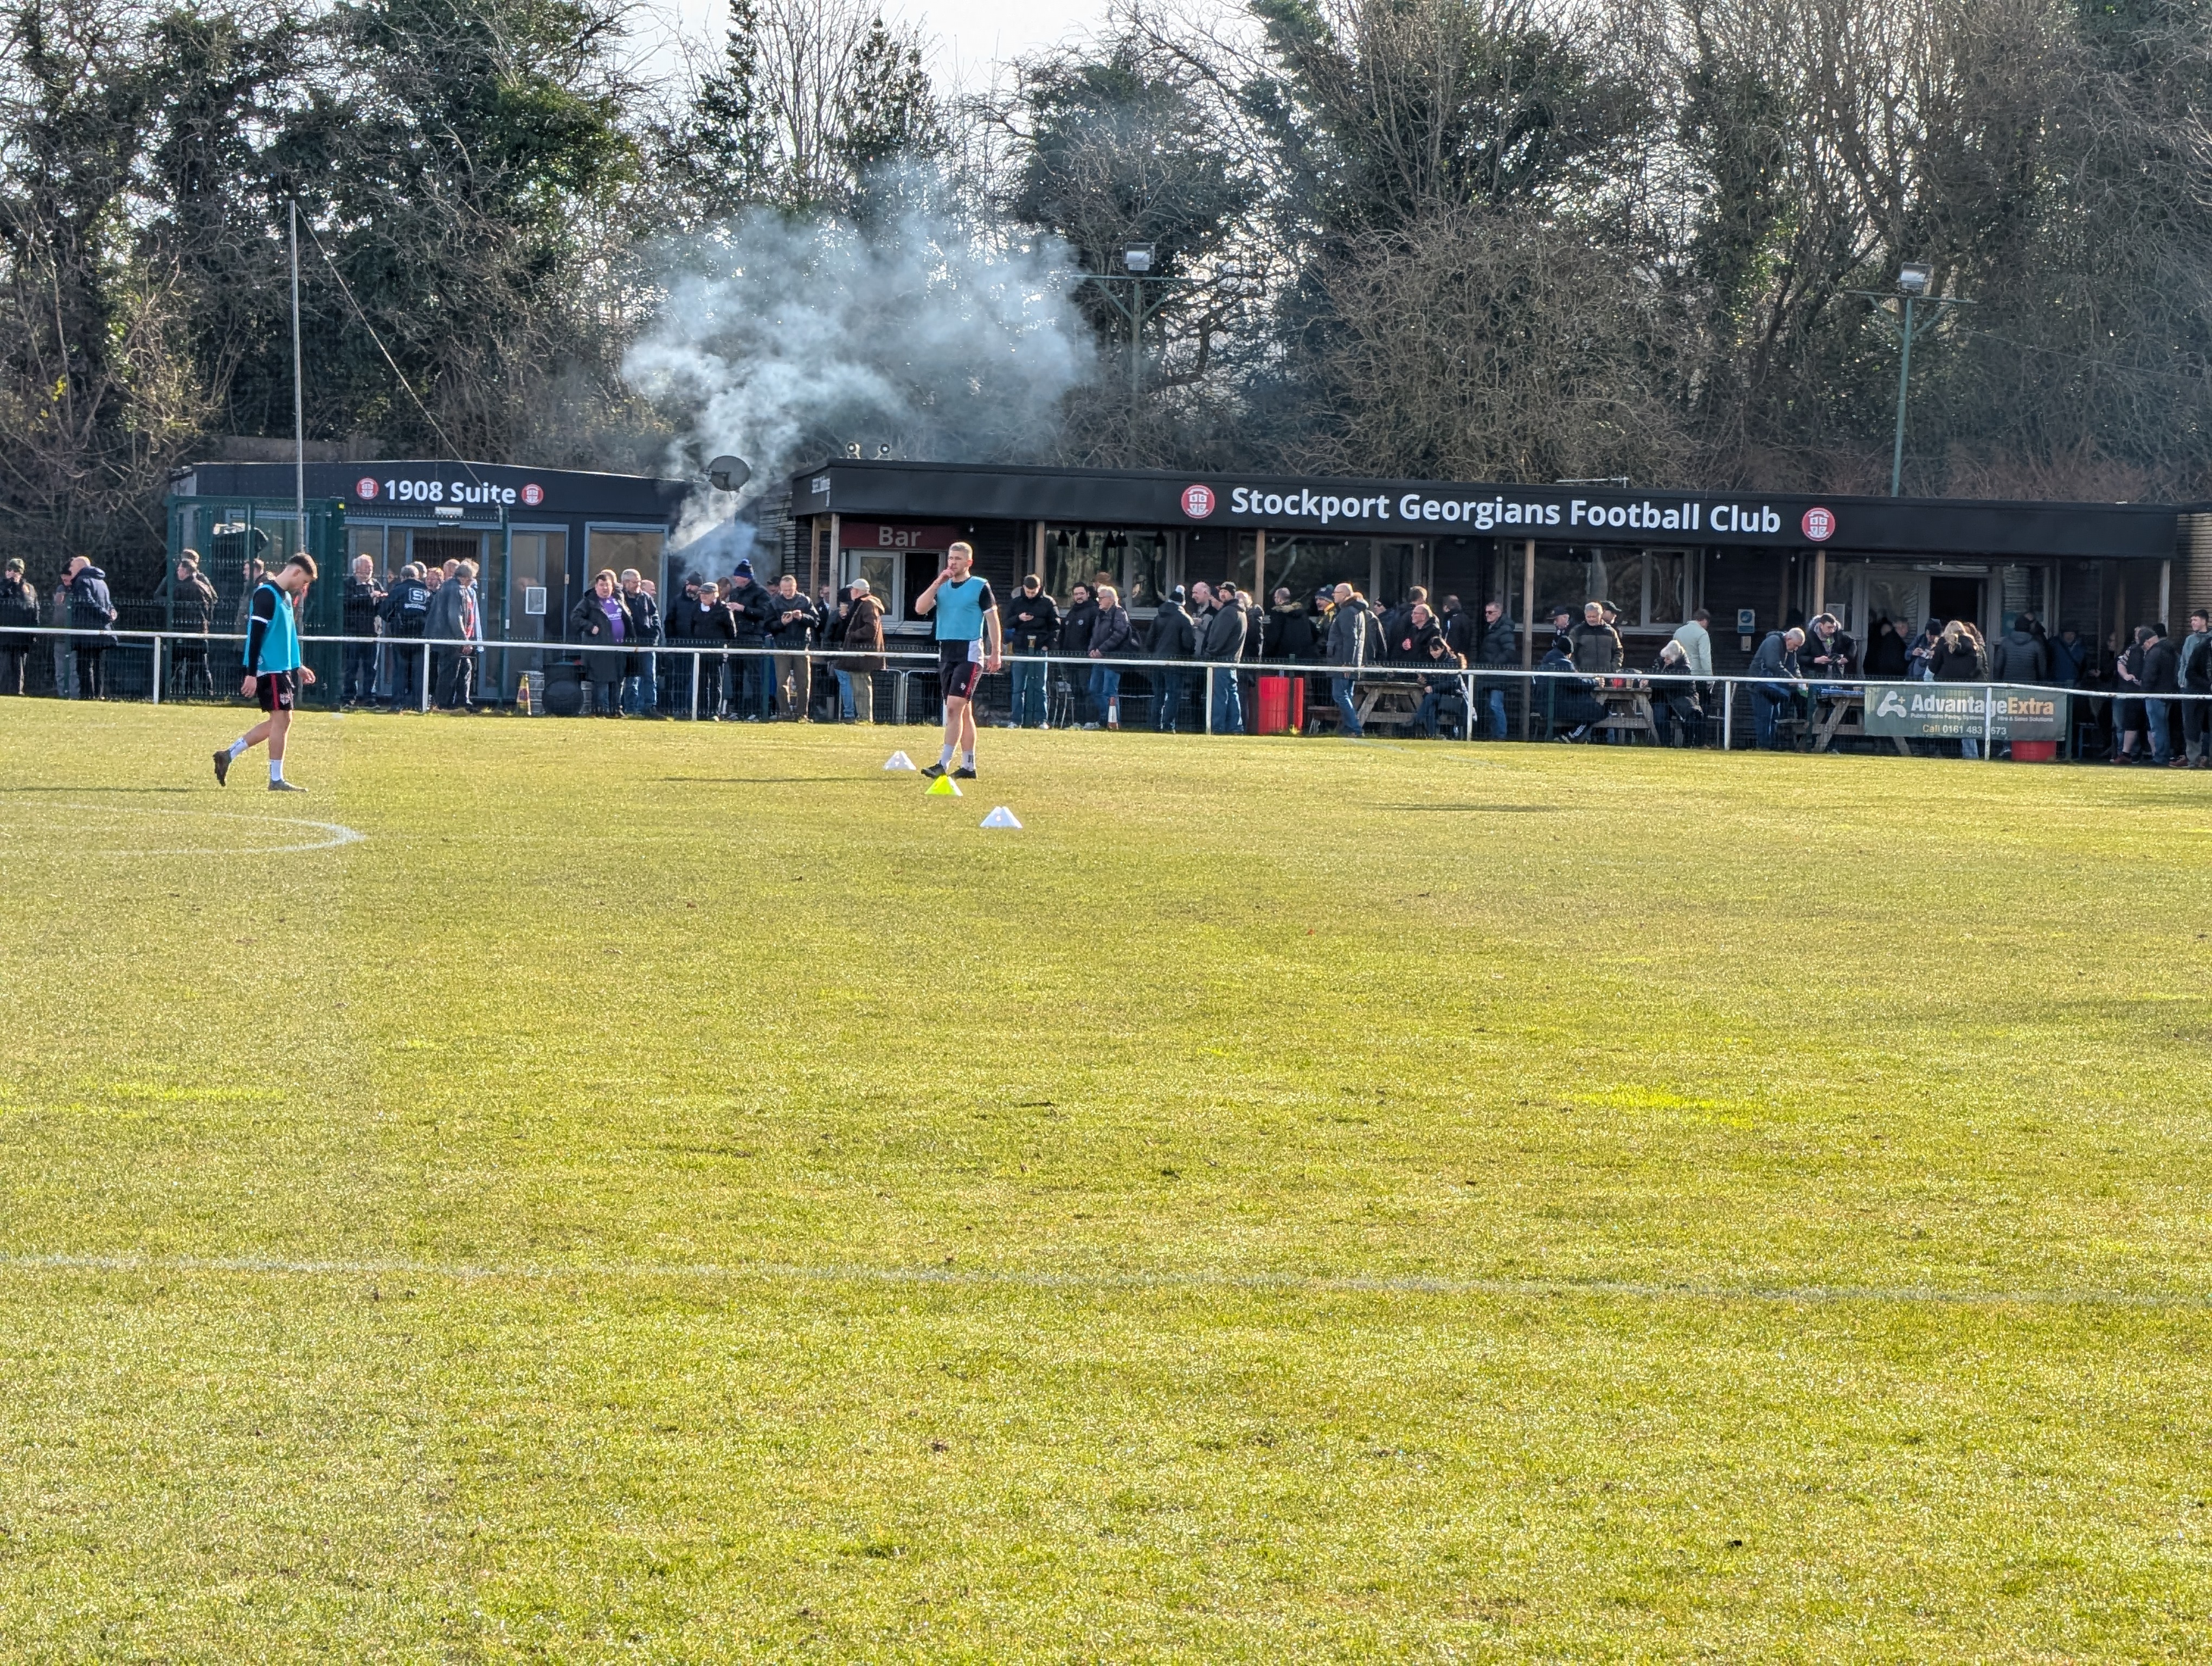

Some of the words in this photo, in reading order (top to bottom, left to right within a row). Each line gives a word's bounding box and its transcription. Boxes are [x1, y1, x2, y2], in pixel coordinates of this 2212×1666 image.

[384, 479, 443, 501] 1908
[450, 482, 516, 504] Suite
[1231, 487, 1390, 524] Stockport
[1399, 494, 1560, 530] Georgians
[1571, 499, 1700, 529] Football
[1710, 504, 1780, 533] Club
[879, 526, 921, 547] Bar
[1922, 724, 1940, 733] Call
[1943, 725, 1963, 733] 0161
[1966, 726, 1983, 734] 483
[1990, 726, 2007, 735] 673
